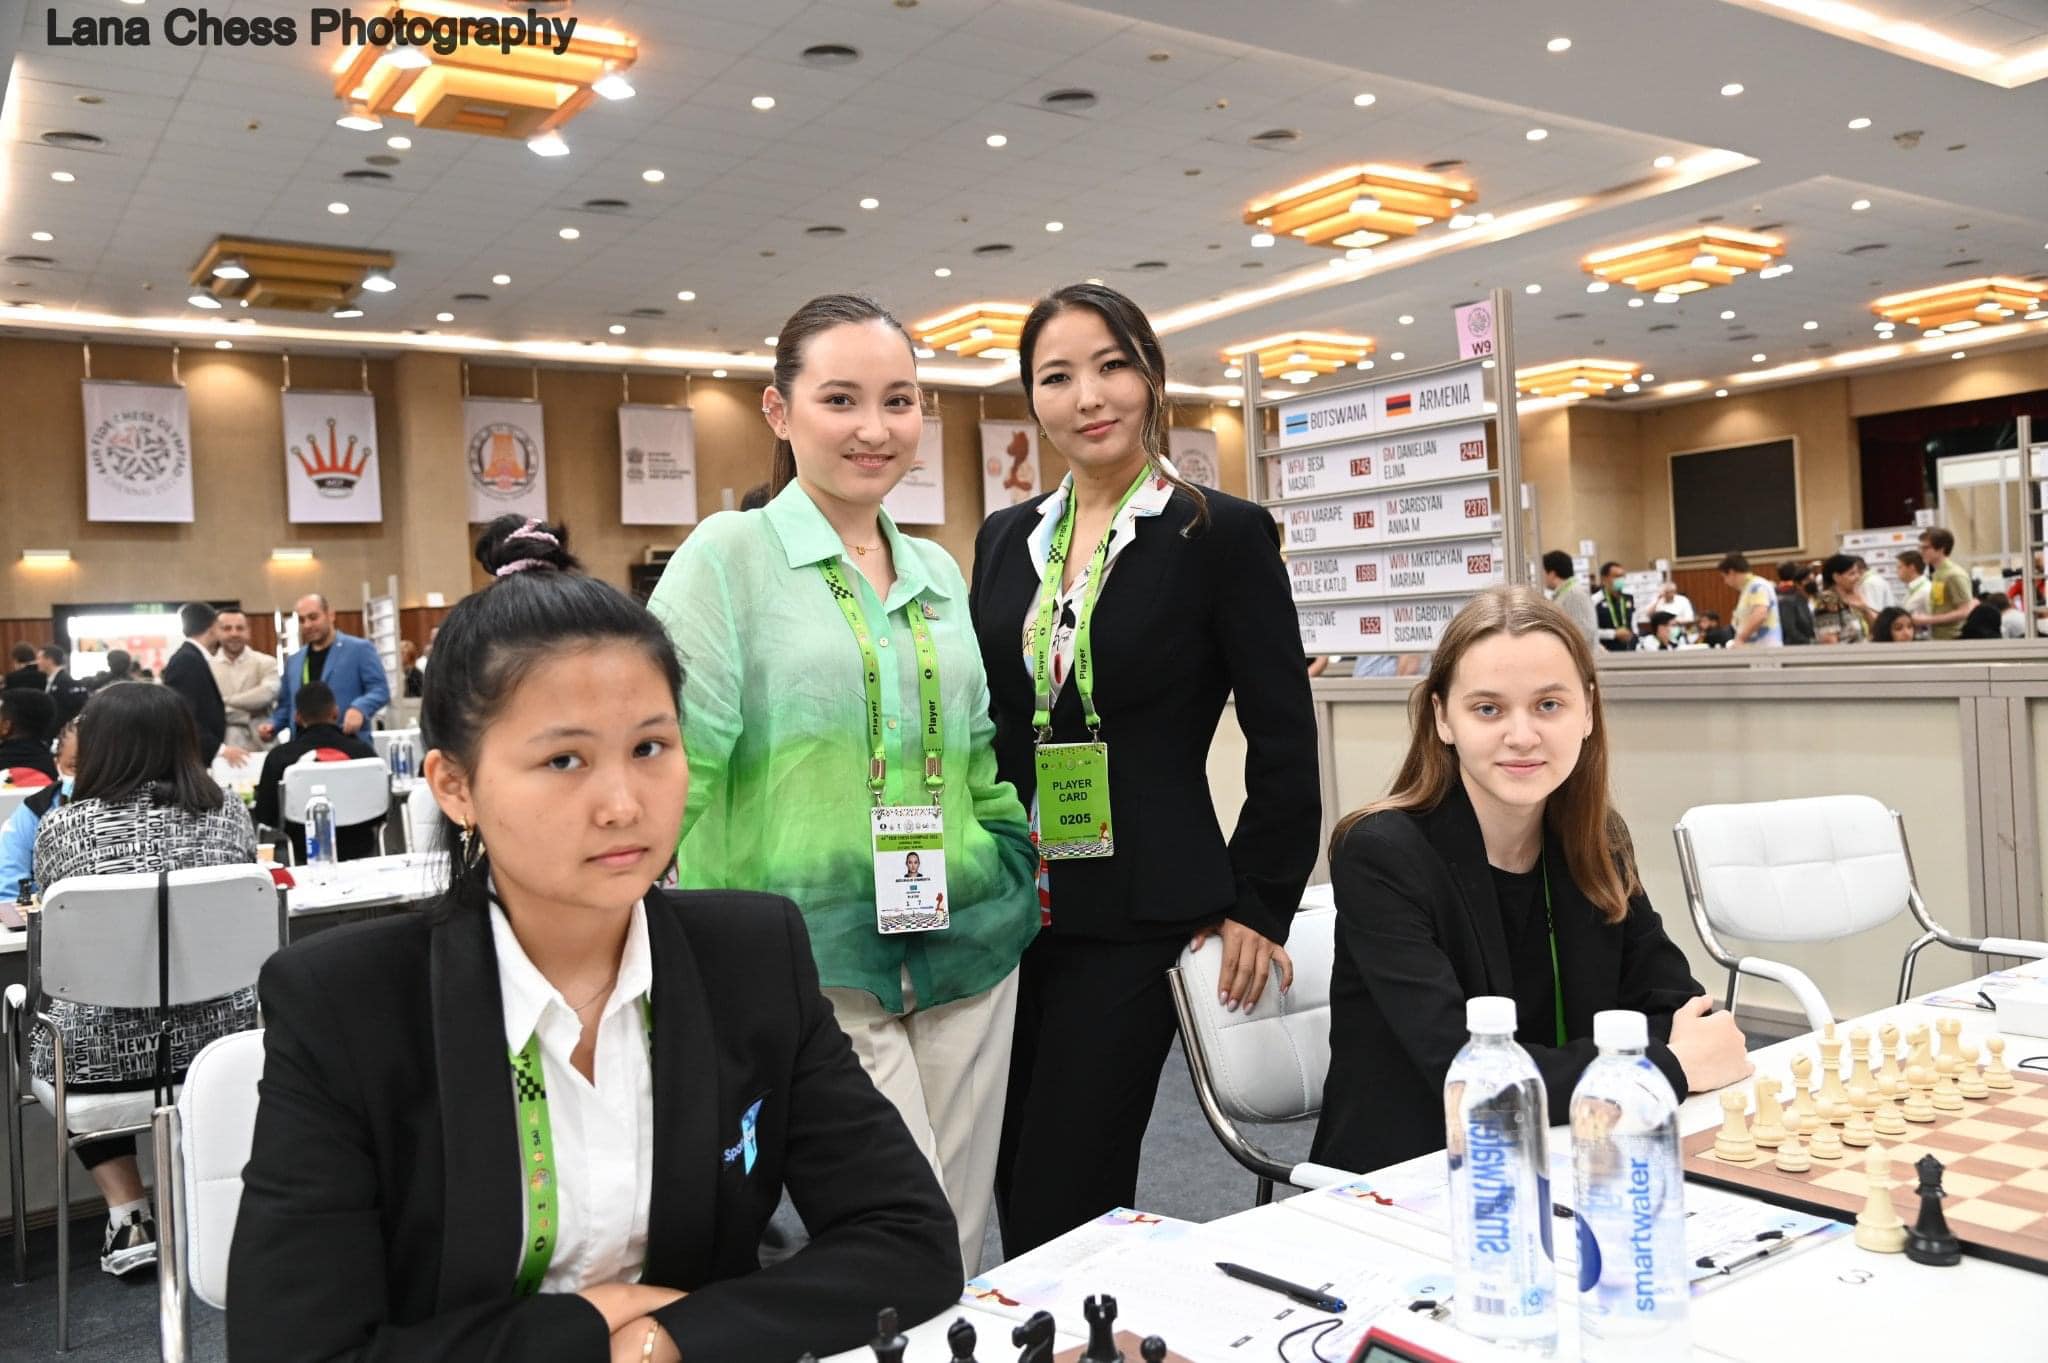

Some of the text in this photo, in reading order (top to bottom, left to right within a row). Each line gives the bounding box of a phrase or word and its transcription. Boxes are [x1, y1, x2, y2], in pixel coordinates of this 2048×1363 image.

[1472, 340, 1491, 355] W9
[1419, 383, 1470, 412] ARMENIA
[1310, 402, 1367, 430] BOTSWANA
[1397, 440, 1437, 460] DANIELIAN
[1384, 464, 1405, 480] ELINA
[1400, 496, 1442, 514] SARGSYAN
[1465, 498, 1488, 518] 2378
[1290, 506, 1343, 526] WFM MARAPE
[1388, 517, 1420, 534] ANNA M
[1390, 548, 1463, 569] WIM MKRTCHYAN
[1324, 577, 1347, 592] KATLO
[1390, 571, 1425, 588] MARIAM
[1394, 603, 1454, 623] WIM GABOYAN
[1395, 626, 1432, 642] SUSANNA
[1037, 650, 1046, 681] Player
[1079, 648, 1088, 680] Player
[871, 701, 882, 736] Player
[928, 700, 938, 734] Player
[1052, 778, 1092, 791] PLAYER
[1058, 791, 1088, 803] CARD
[1060, 813, 1091, 826] 0205
[1627, 1157, 1656, 1312] smartwater
